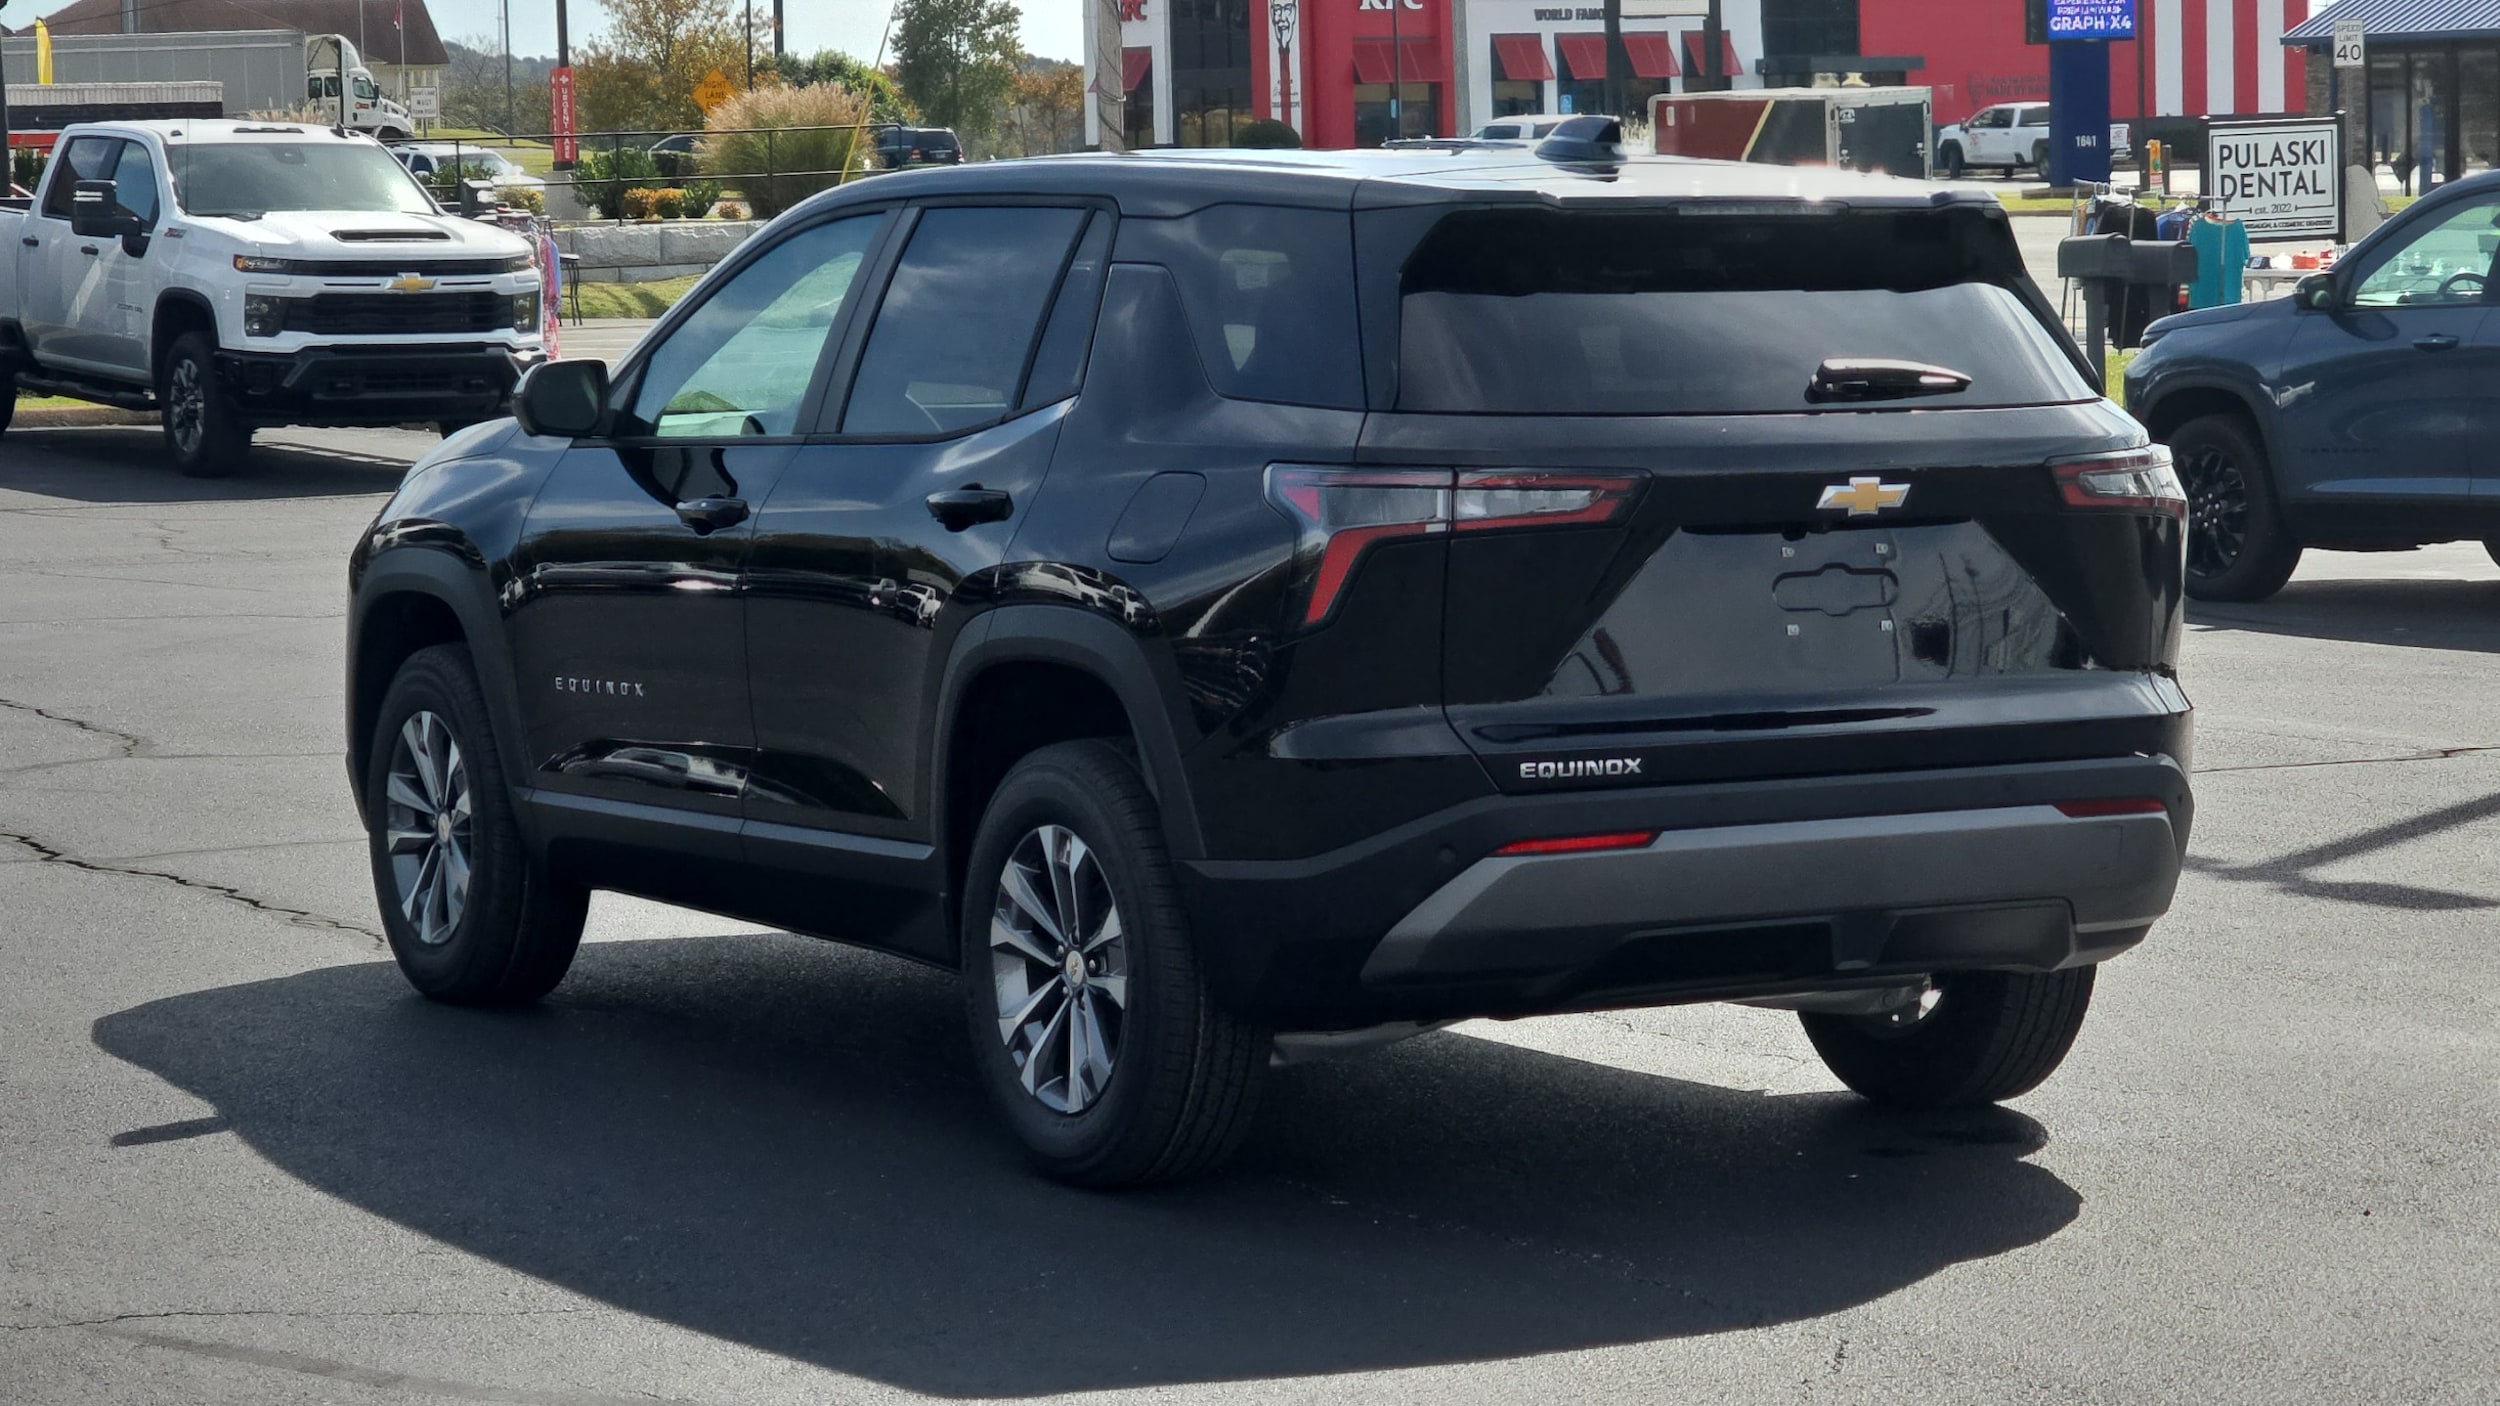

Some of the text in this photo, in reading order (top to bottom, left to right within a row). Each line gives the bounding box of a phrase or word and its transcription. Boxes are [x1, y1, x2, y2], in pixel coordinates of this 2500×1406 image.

[1534, 8, 1605, 21] WORLD FAMO
[2337, 24, 2361, 32] SPEED
[2336, 44, 2361, 60] 40
[561, 87, 569, 128] URGENT
[2075, 135, 2096, 147] 1641
[2219, 140, 2325, 169] PULASKI
[2220, 170, 2326, 199] DENTAL
[2271, 203, 2292, 214] 2022
[555, 677, 643, 696] EQUINOX
[1519, 758, 1641, 779] EQUINOX
